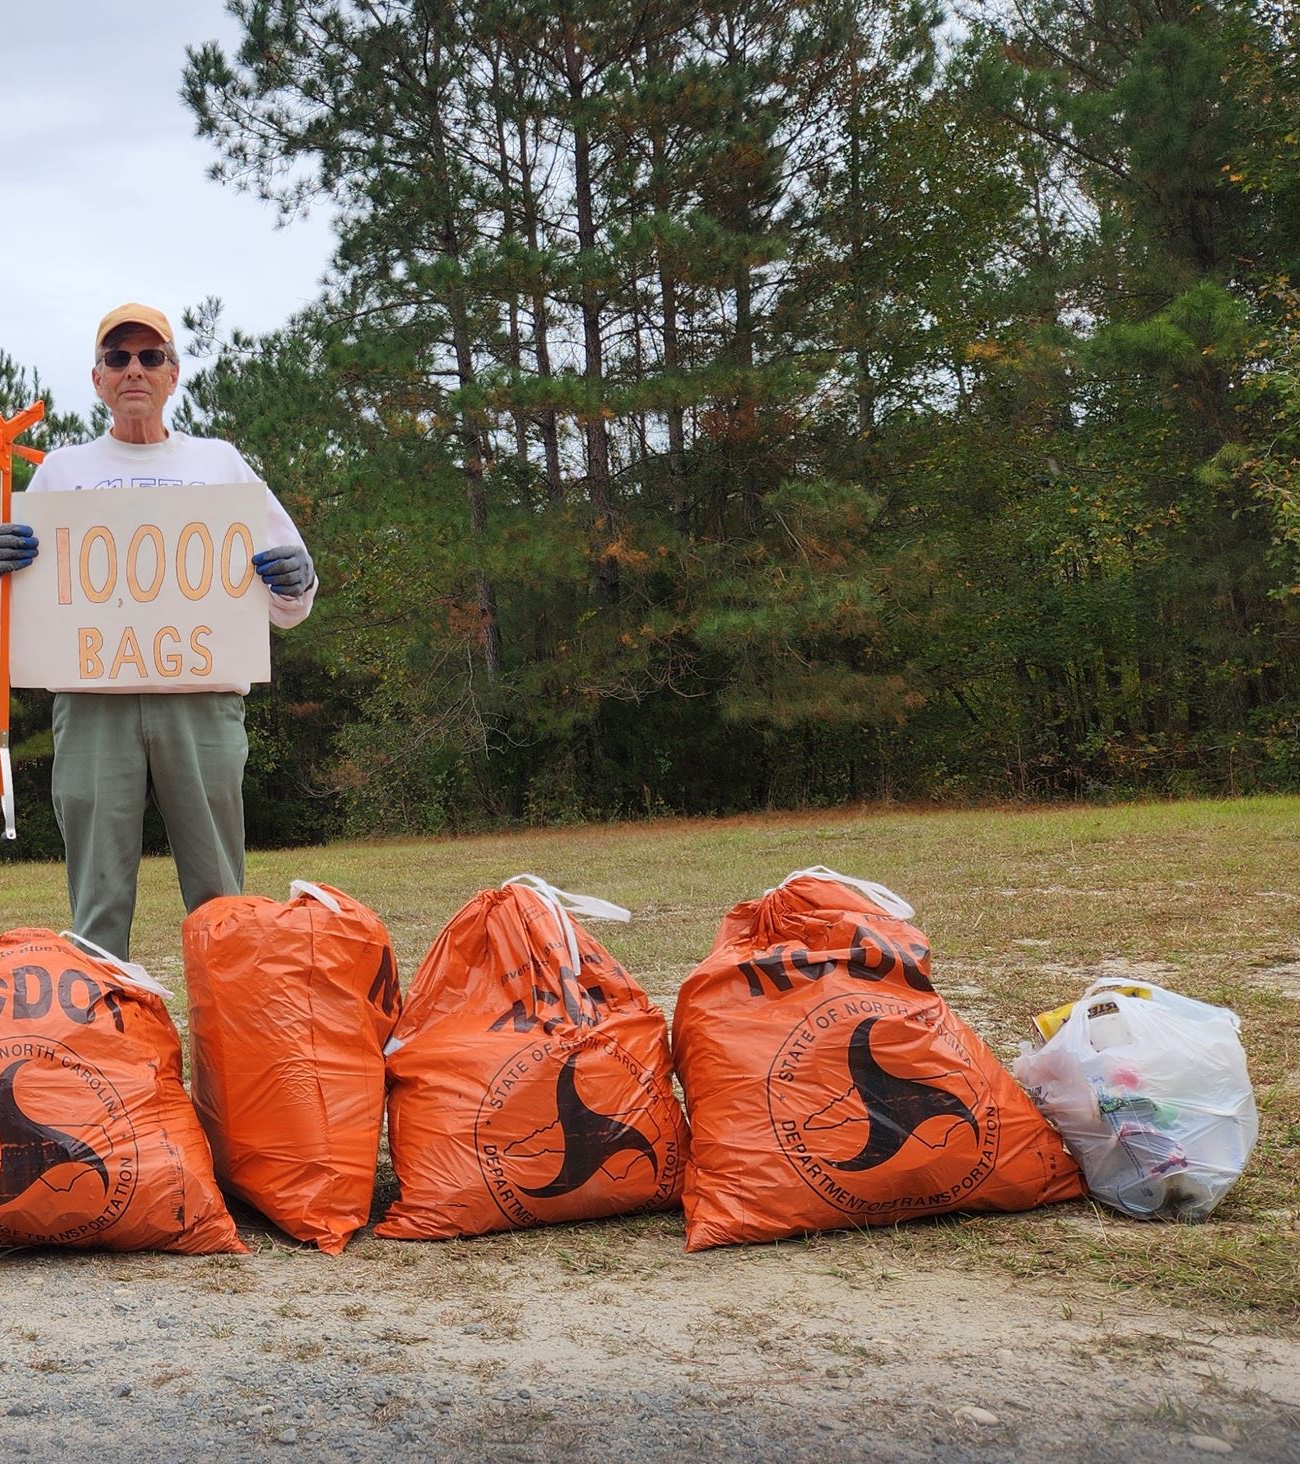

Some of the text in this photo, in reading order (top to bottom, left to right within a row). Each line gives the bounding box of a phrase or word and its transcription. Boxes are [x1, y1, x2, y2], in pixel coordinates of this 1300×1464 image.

[55, 522, 254, 608] 10,000
[78, 625, 212, 680] BAGS
[490, 1061, 530, 1110] STATE
[531, 1043, 552, 1062] OF
[604, 1043, 659, 1106] CAROLNA
[779, 1029, 816, 1083] STATE
[815, 1008, 842, 1030] OF
[844, 1000, 908, 1017] NORTH
[61, 1056, 122, 1121] CAROLINA
[27, 1157, 133, 1242] TRANSPORTATION
[781, 1120, 868, 1210] DEPARTMENT
[890, 1106, 998, 1209] TRANSPORTATION
